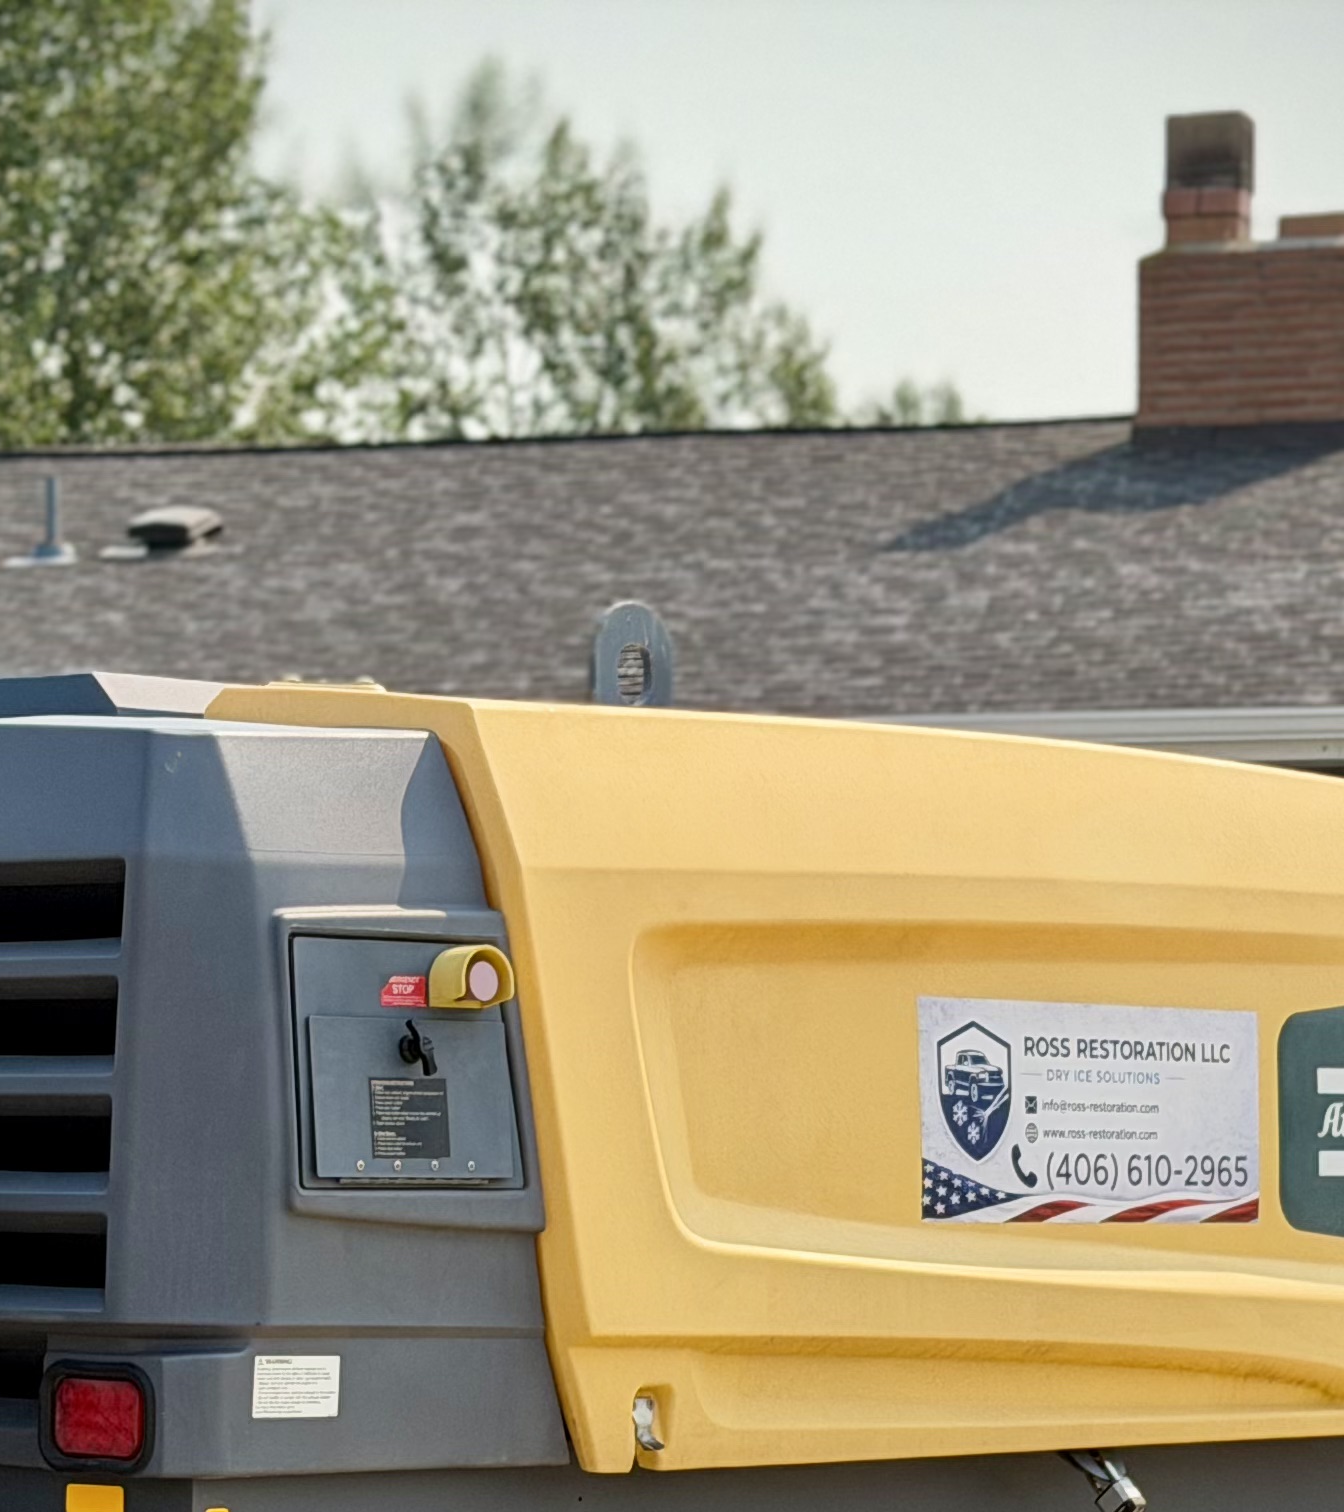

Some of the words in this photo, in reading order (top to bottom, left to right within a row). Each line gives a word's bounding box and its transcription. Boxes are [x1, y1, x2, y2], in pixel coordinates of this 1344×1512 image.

[392, 984, 414, 994] STOP
[1024, 1036, 1071, 1058] ROSS
[1076, 1038, 1196, 1062] RESTORATION
[1201, 1043, 1231, 1063] LLC
[1046, 1069, 1069, 1082] DRY
[1073, 1070, 1092, 1083] ICE
[1096, 1071, 1161, 1085] SOLUTIONS
[1041, 1098, 1159, 1115] info@ross-restoration.com
[1042, 1128, 1158, 1141] www.ross-restoration.com
[1046, 1151, 1119, 1191] (406)
[1127, 1153, 1249, 1187] 610-2965
